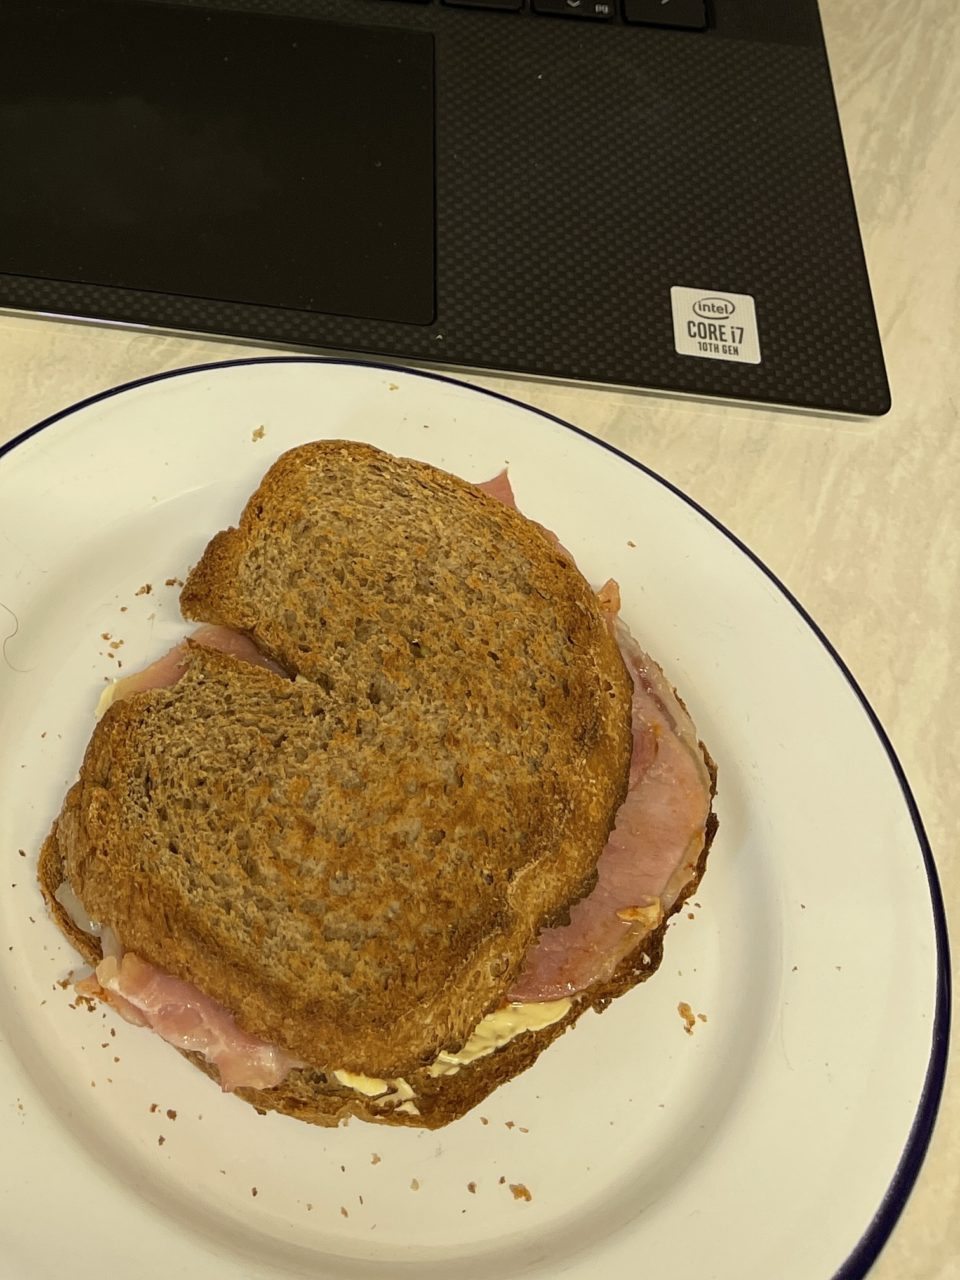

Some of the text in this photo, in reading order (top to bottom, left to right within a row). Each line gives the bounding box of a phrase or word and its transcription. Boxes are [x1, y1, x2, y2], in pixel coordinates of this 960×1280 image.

[594, 3, 610, 15] pg
[697, 300, 729, 315] intel
[687, 320, 744, 345] CORE i7
[697, 341, 740, 357] 10TH GEN
